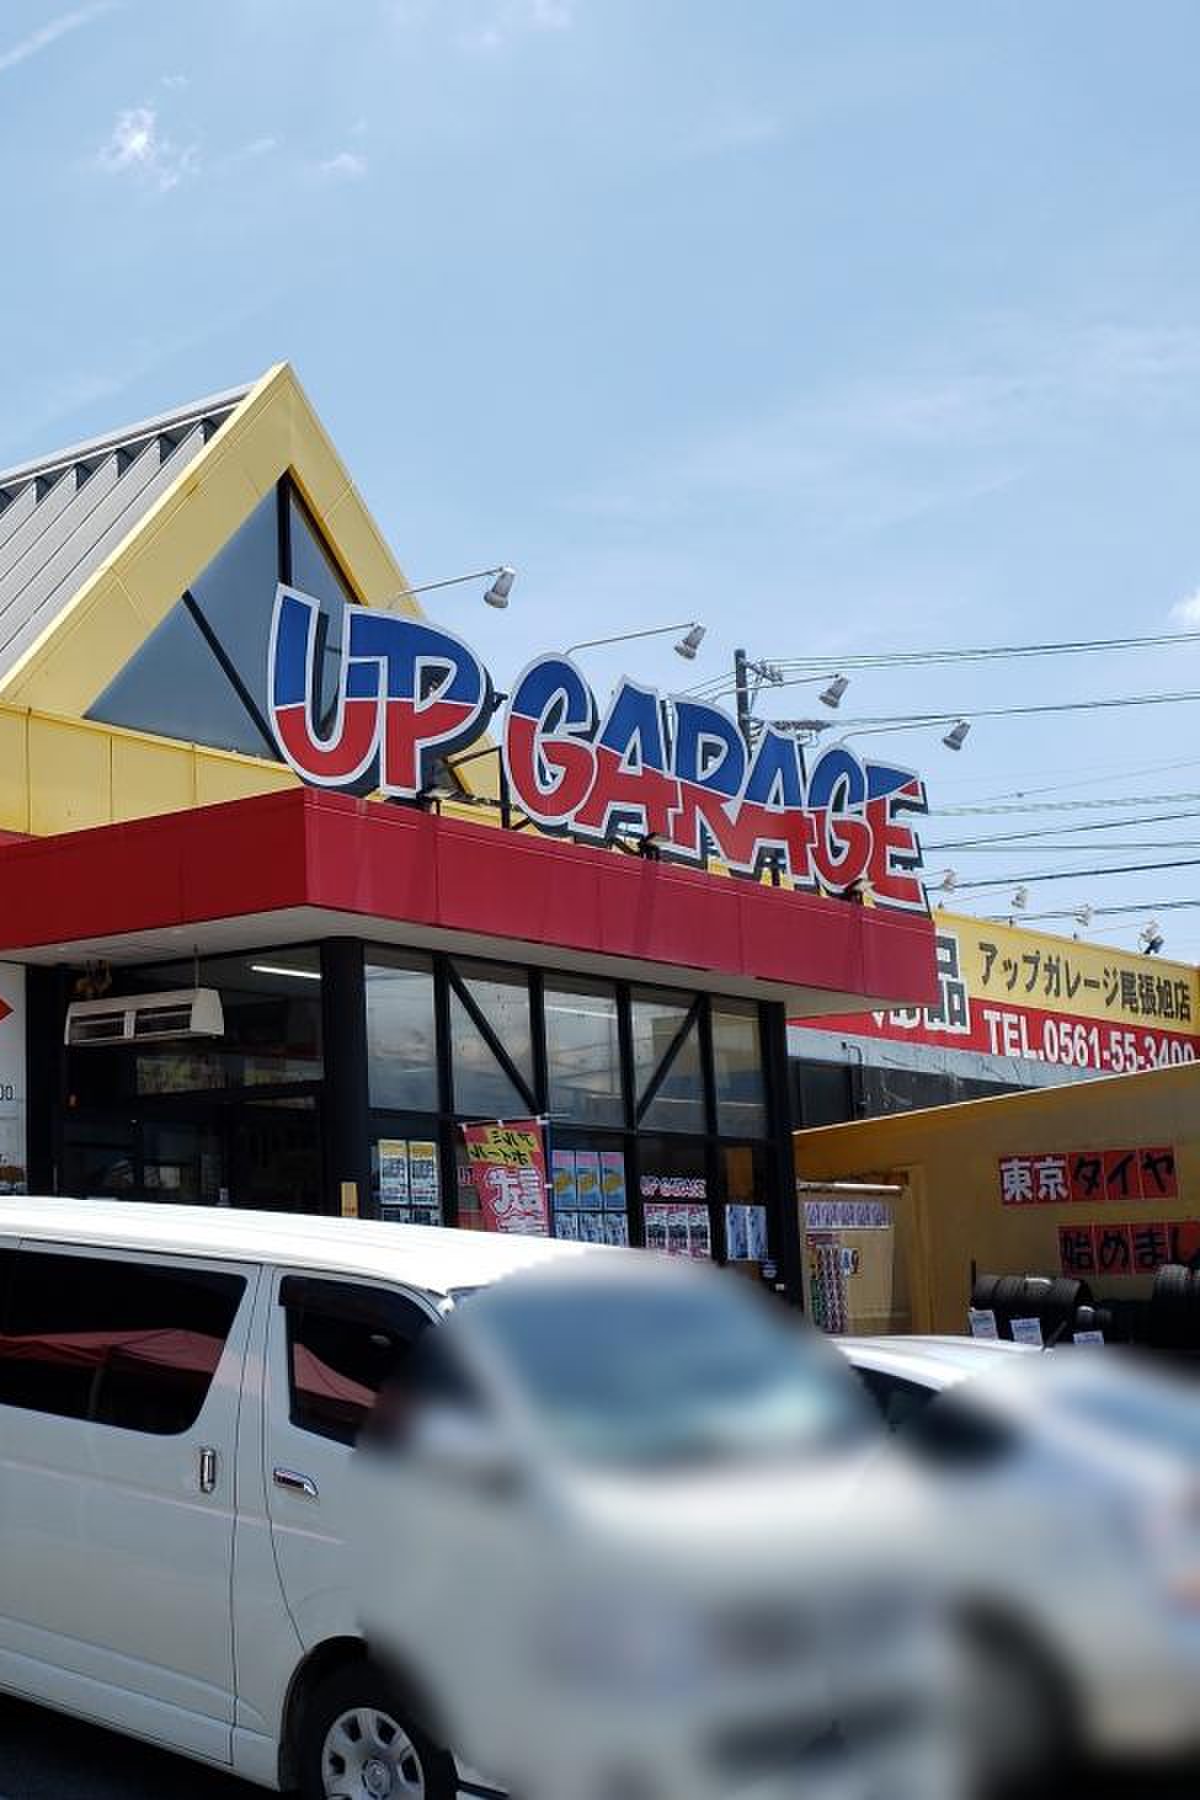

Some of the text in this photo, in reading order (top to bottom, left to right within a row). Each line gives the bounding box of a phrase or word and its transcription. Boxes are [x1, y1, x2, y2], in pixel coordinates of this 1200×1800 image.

[269, 584, 928, 913] UP GARAGE
[978, 941, 1191, 1021] アップガレージ尾張旭店
[1001, 1152, 1175, 1201] 東京タイヤ
